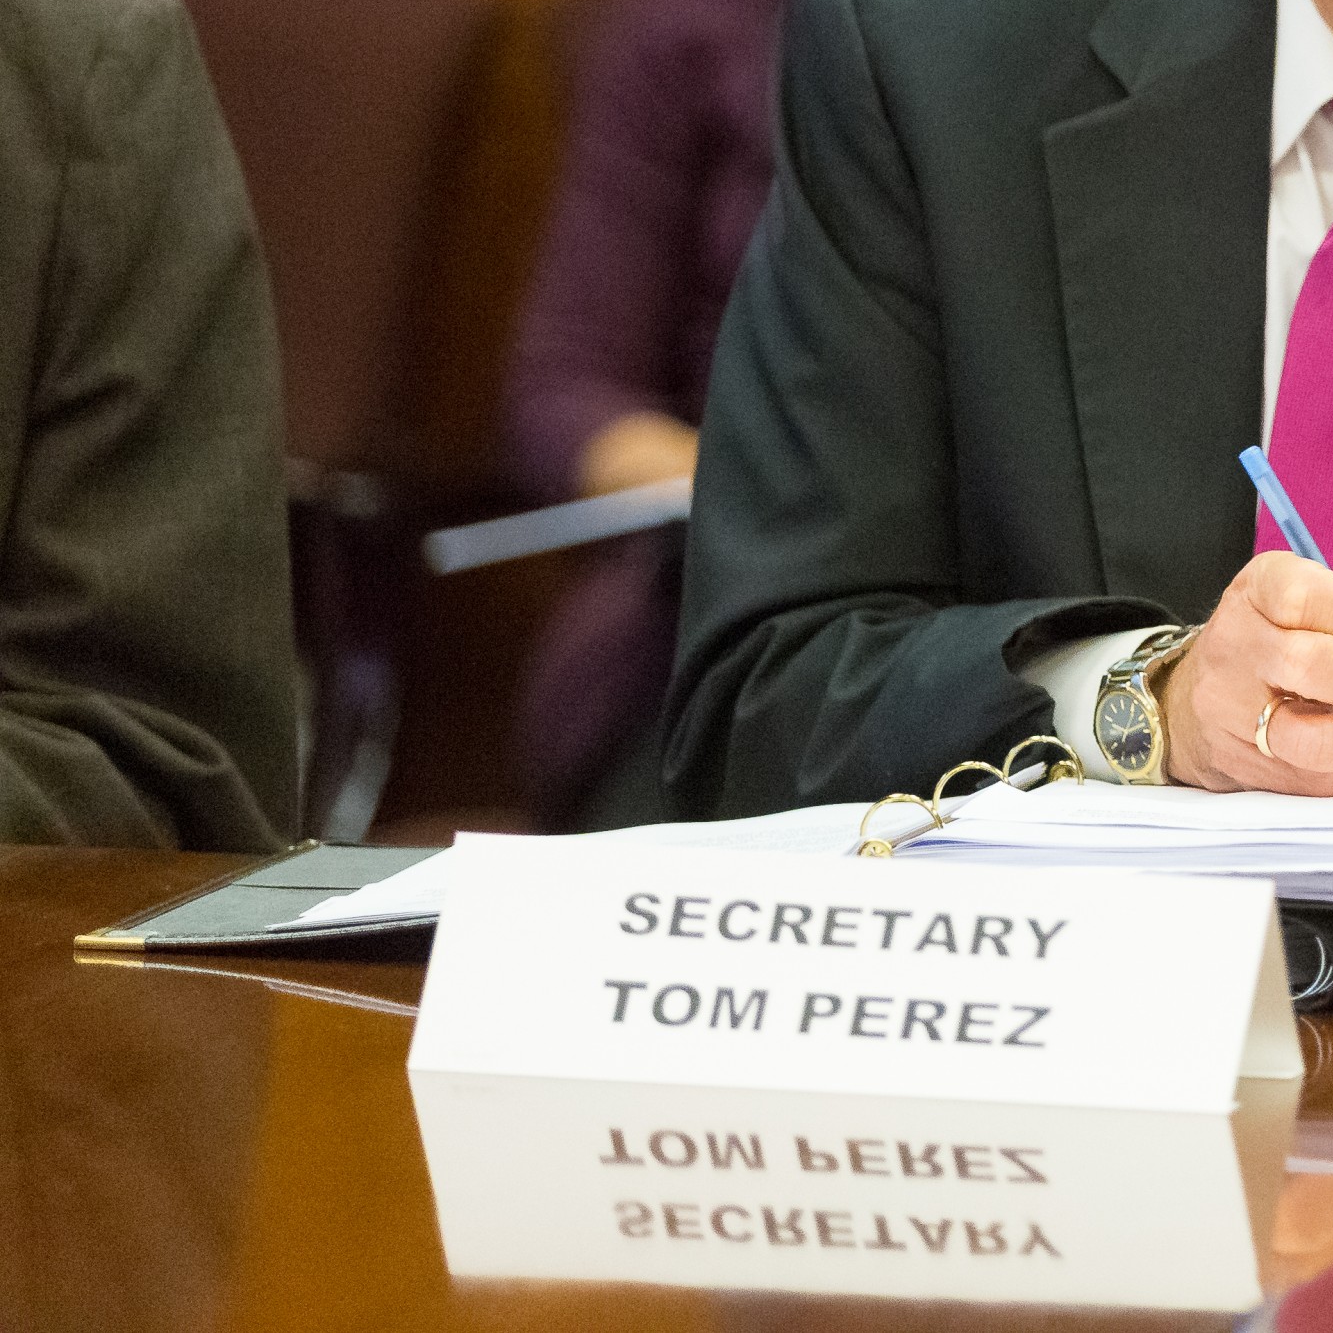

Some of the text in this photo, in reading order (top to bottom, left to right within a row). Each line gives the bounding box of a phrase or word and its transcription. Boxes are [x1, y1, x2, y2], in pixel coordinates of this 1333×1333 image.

[616, 890, 1069, 960] SECRETARY
[603, 978, 1052, 1049] TOM PEREZ
